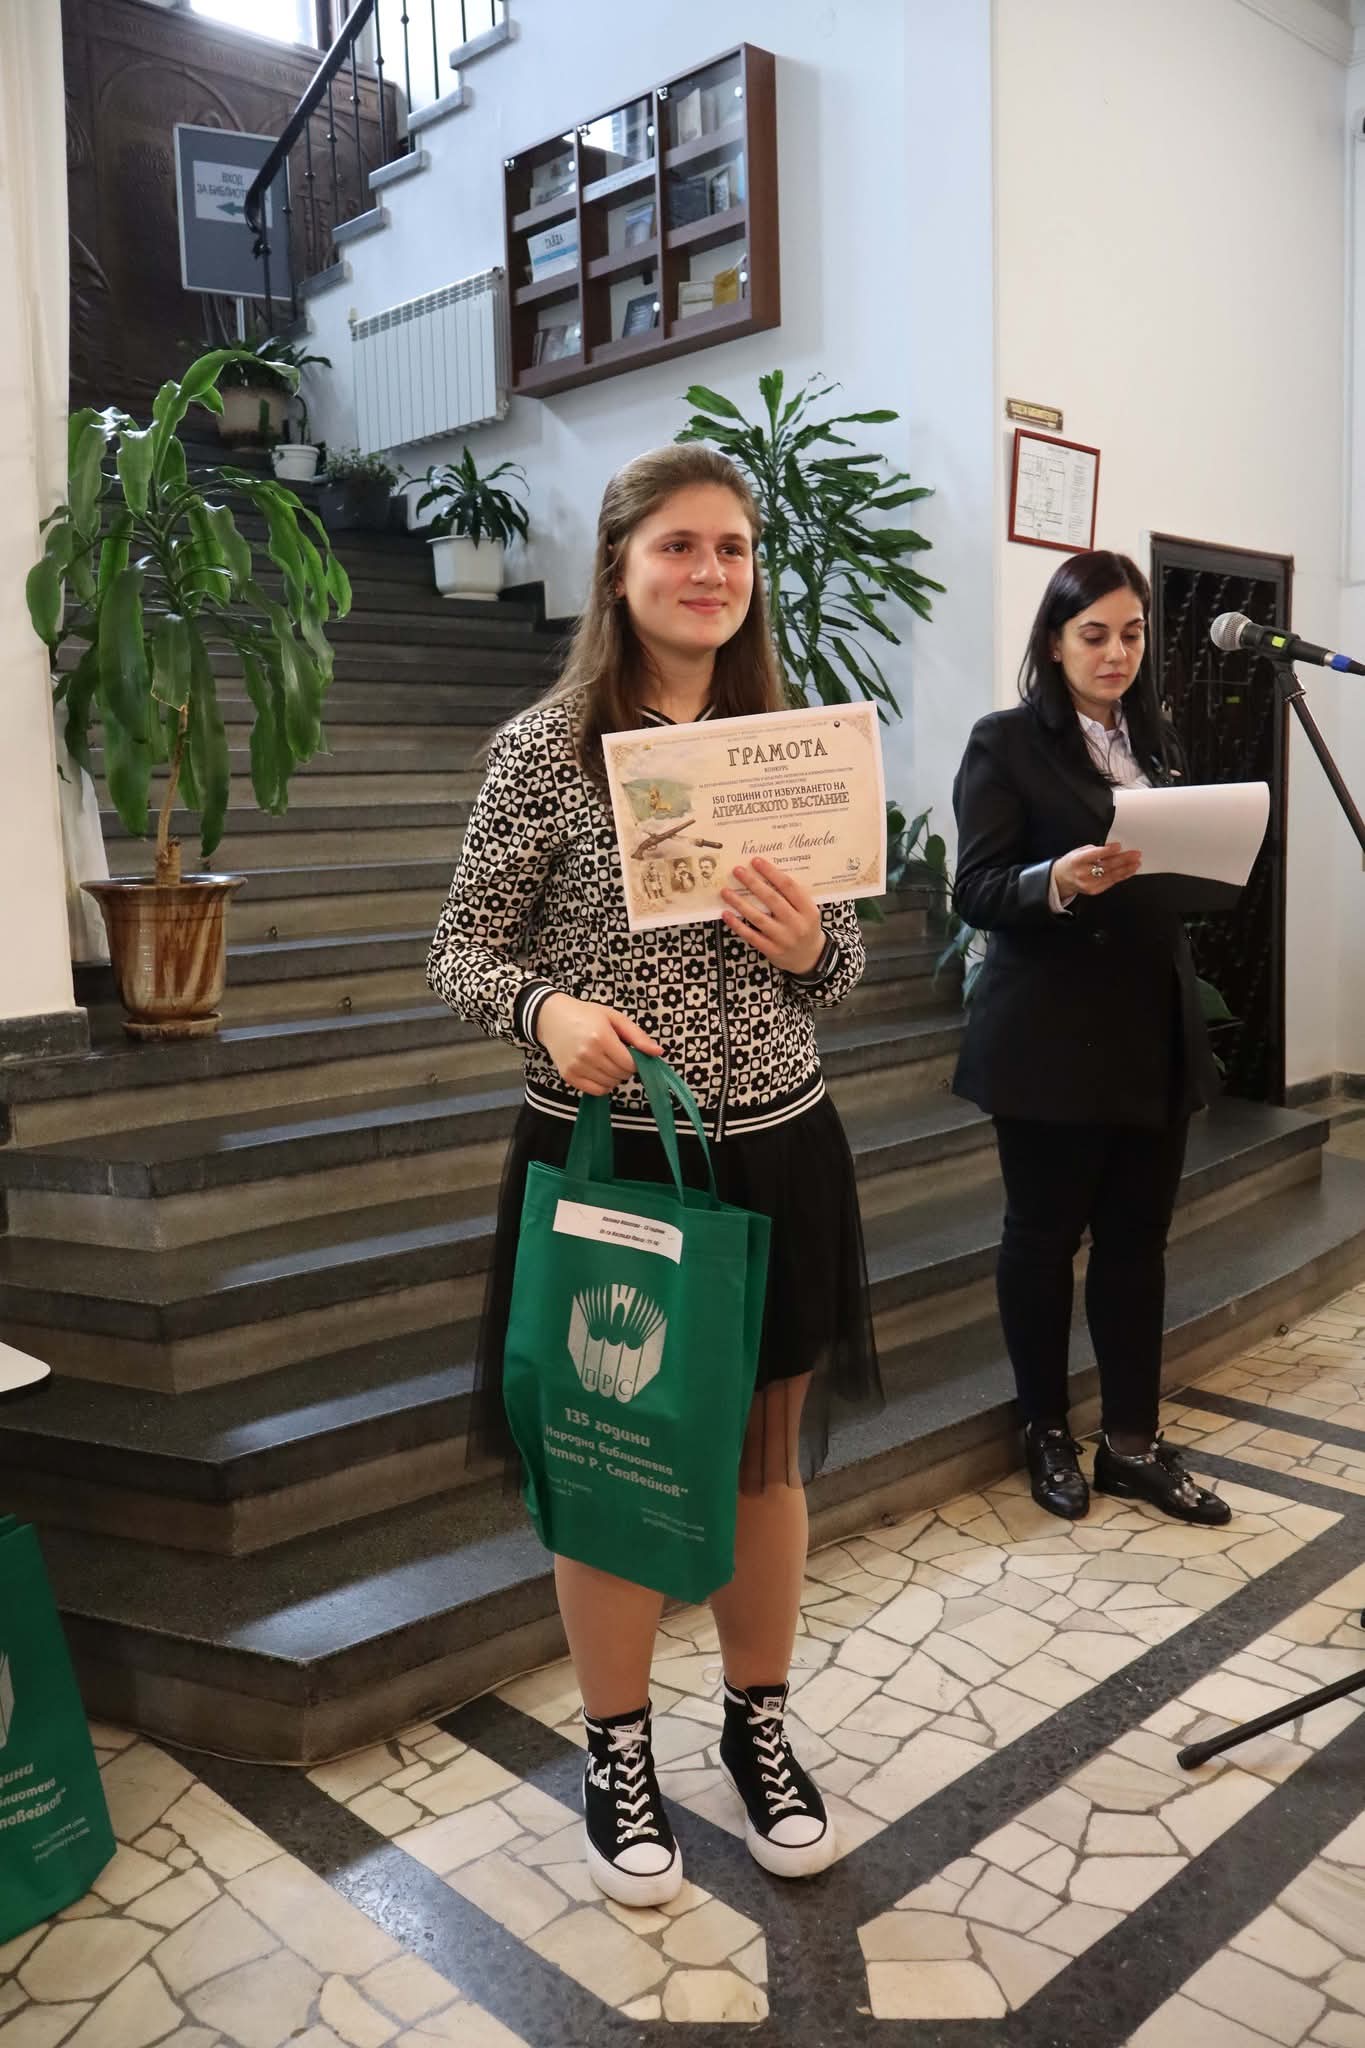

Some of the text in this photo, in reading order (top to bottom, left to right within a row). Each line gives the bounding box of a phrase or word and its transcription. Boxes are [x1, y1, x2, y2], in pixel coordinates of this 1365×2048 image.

[728, 737, 828, 766] ГРАМОТА
[712, 799, 789, 819] АПРИЛСКОТО
[792, 791, 850, 809] ВЪСТАНИЕ
[713, 795, 725, 805] 150
[727, 790, 761, 803] ГОДИНИ
[763, 788, 773, 799] ОТ
[776, 783, 832, 797] ИЗБУХВАНЕТО
[834, 781, 846, 790] НА
[741, 830, 835, 855] Калина Иванова
[565, 1407, 650, 1448] 135 години
[545, 1424, 673, 1476] Народна библиотека
[590, 1456, 602, 1471] Р.
